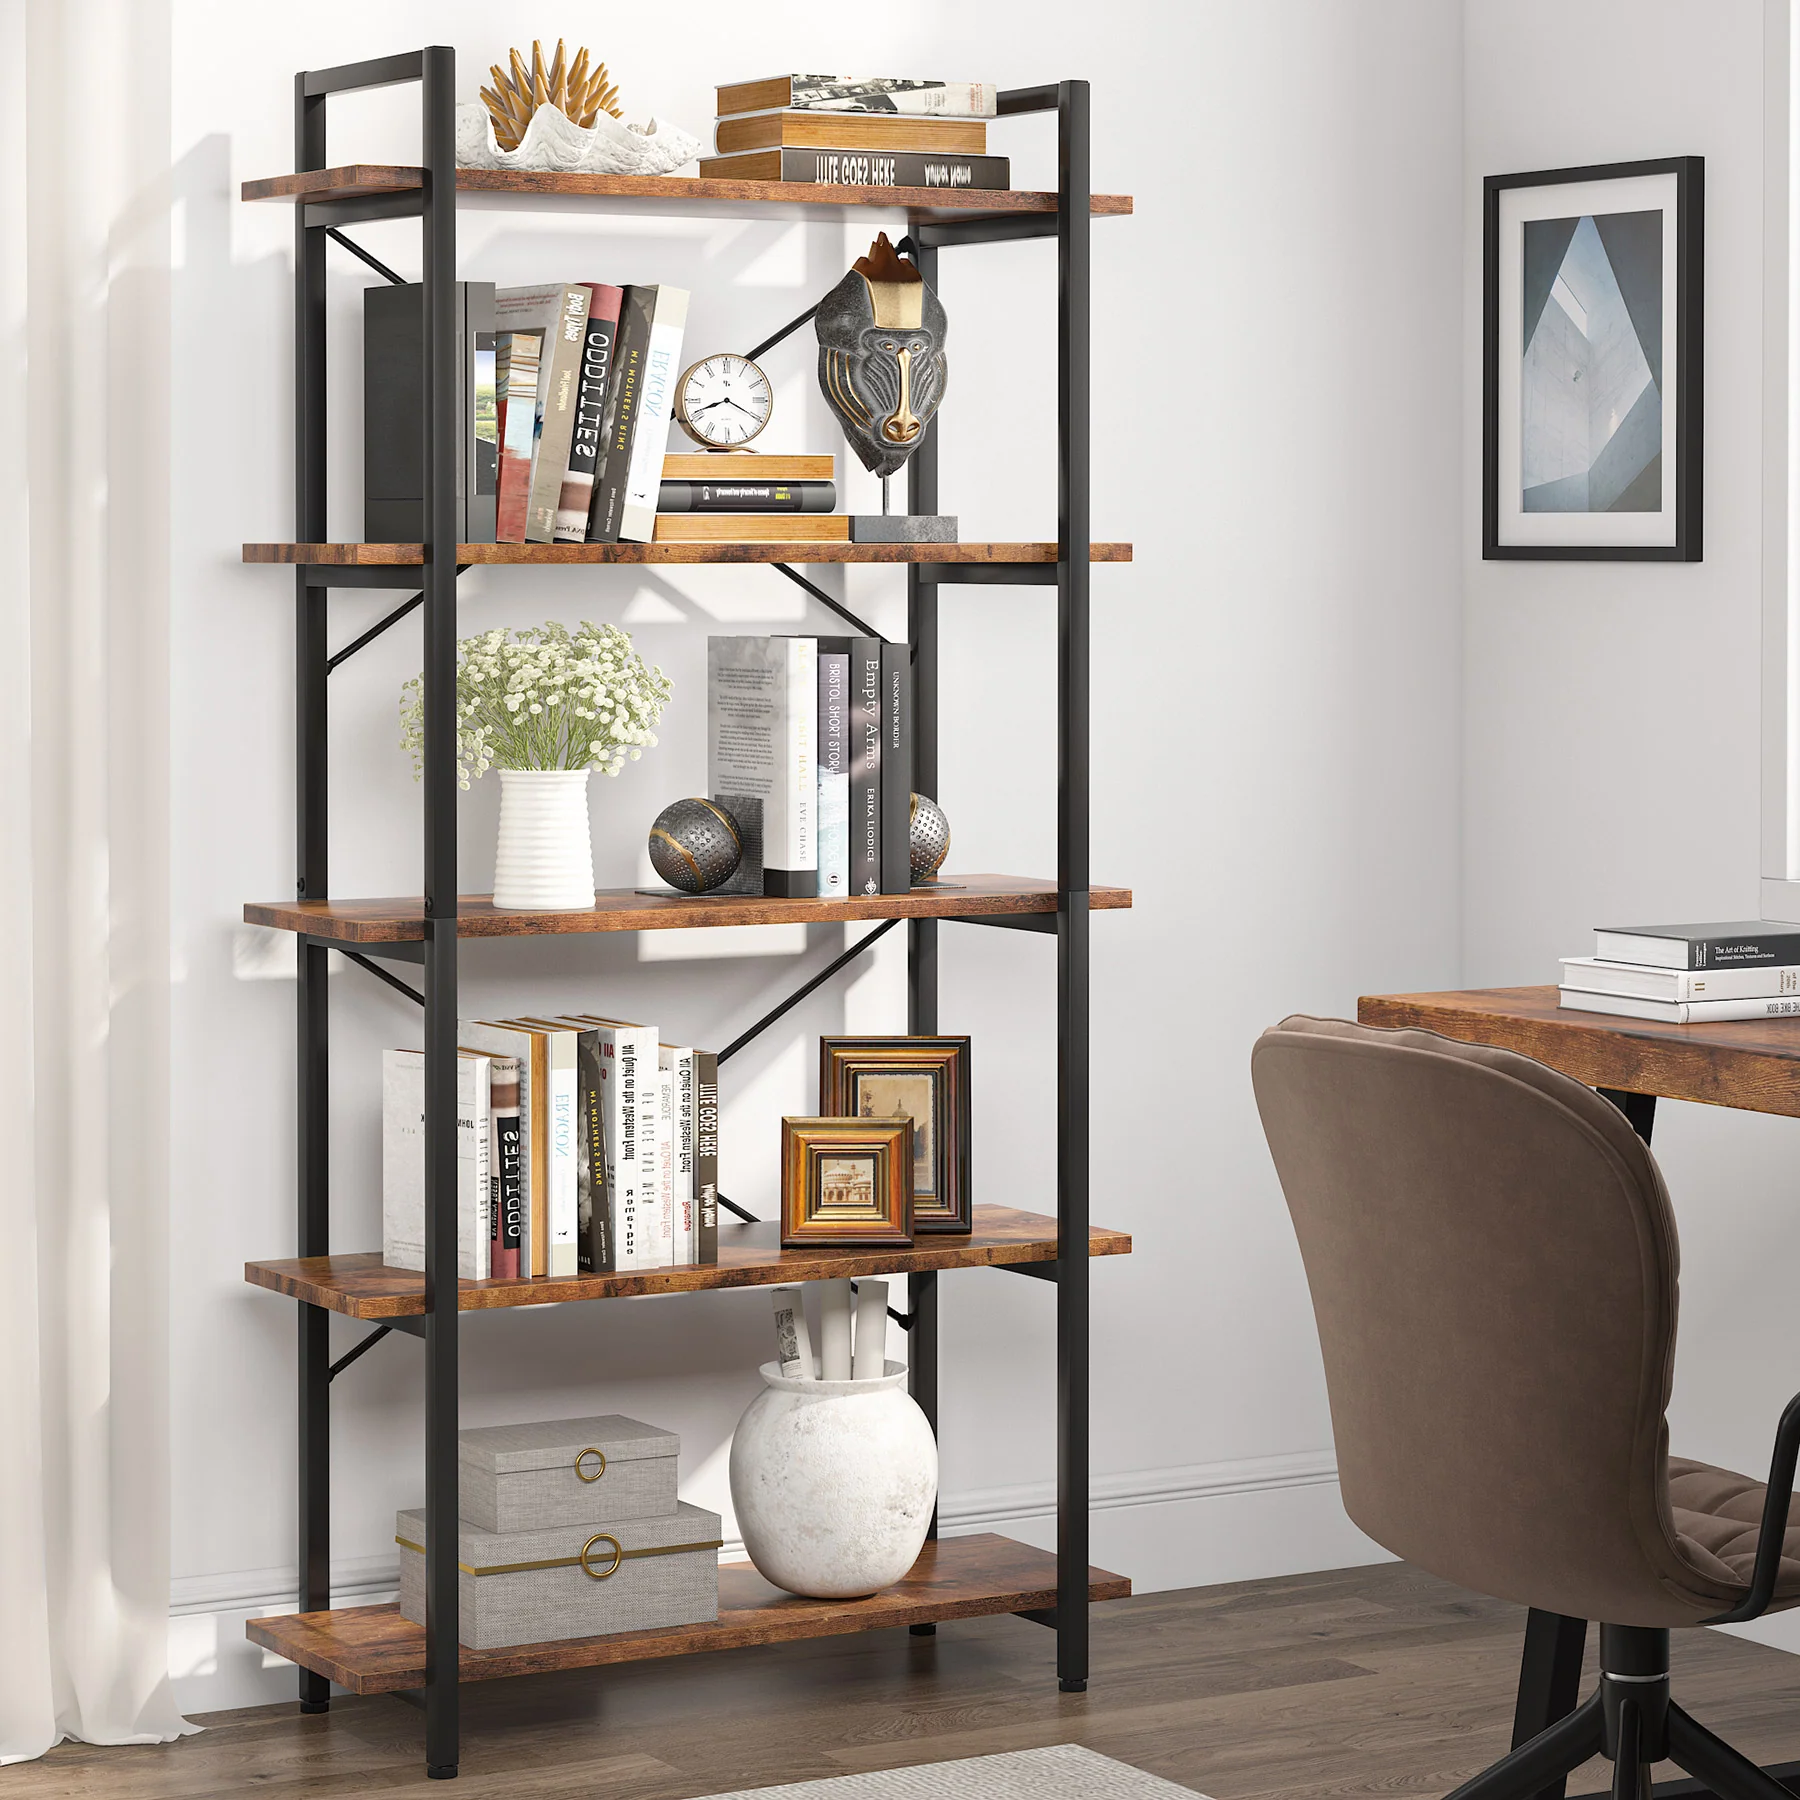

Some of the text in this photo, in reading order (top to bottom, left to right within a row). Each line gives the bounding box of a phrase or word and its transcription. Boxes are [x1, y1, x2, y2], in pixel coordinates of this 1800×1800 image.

[828, 663, 840, 702] BRISTOL
[828, 705, 840, 738] SHORT
[862, 660, 879, 770] Empty Arms
[892, 671, 900, 749] UNKNOWN BORDER
[799, 755, 807, 791] HALL
[828, 741, 840, 774] STORY
[866, 788, 875, 863] ERIKA LIODICE
[1714, 946, 1724, 954] The
[1724, 946, 1733, 954] Art
[1740, 945, 1758, 954] Knitting
